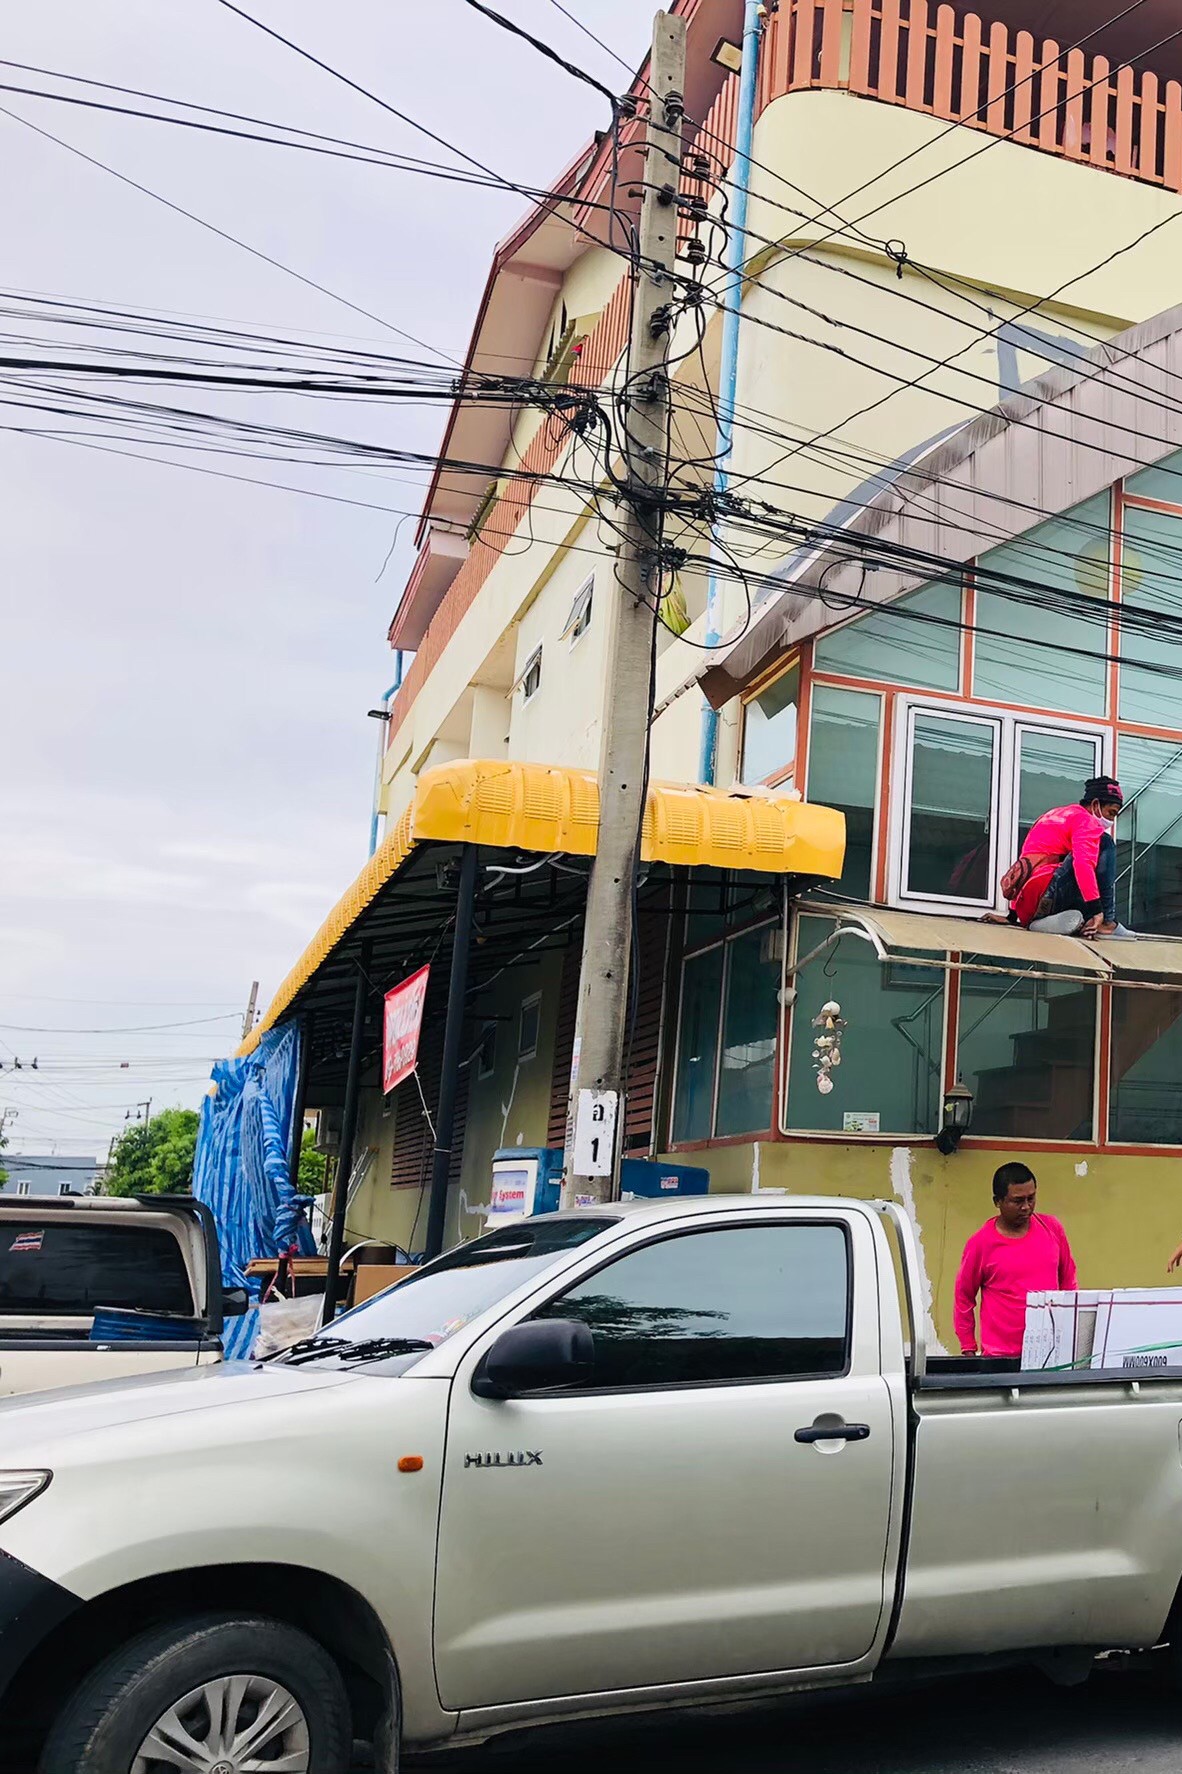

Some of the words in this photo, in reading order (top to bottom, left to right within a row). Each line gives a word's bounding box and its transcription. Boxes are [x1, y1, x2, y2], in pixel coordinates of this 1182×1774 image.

[591, 1137, 600, 1163] 1
[499, 1190, 525, 1202] System
[464, 1449, 543, 1468] HILUX
